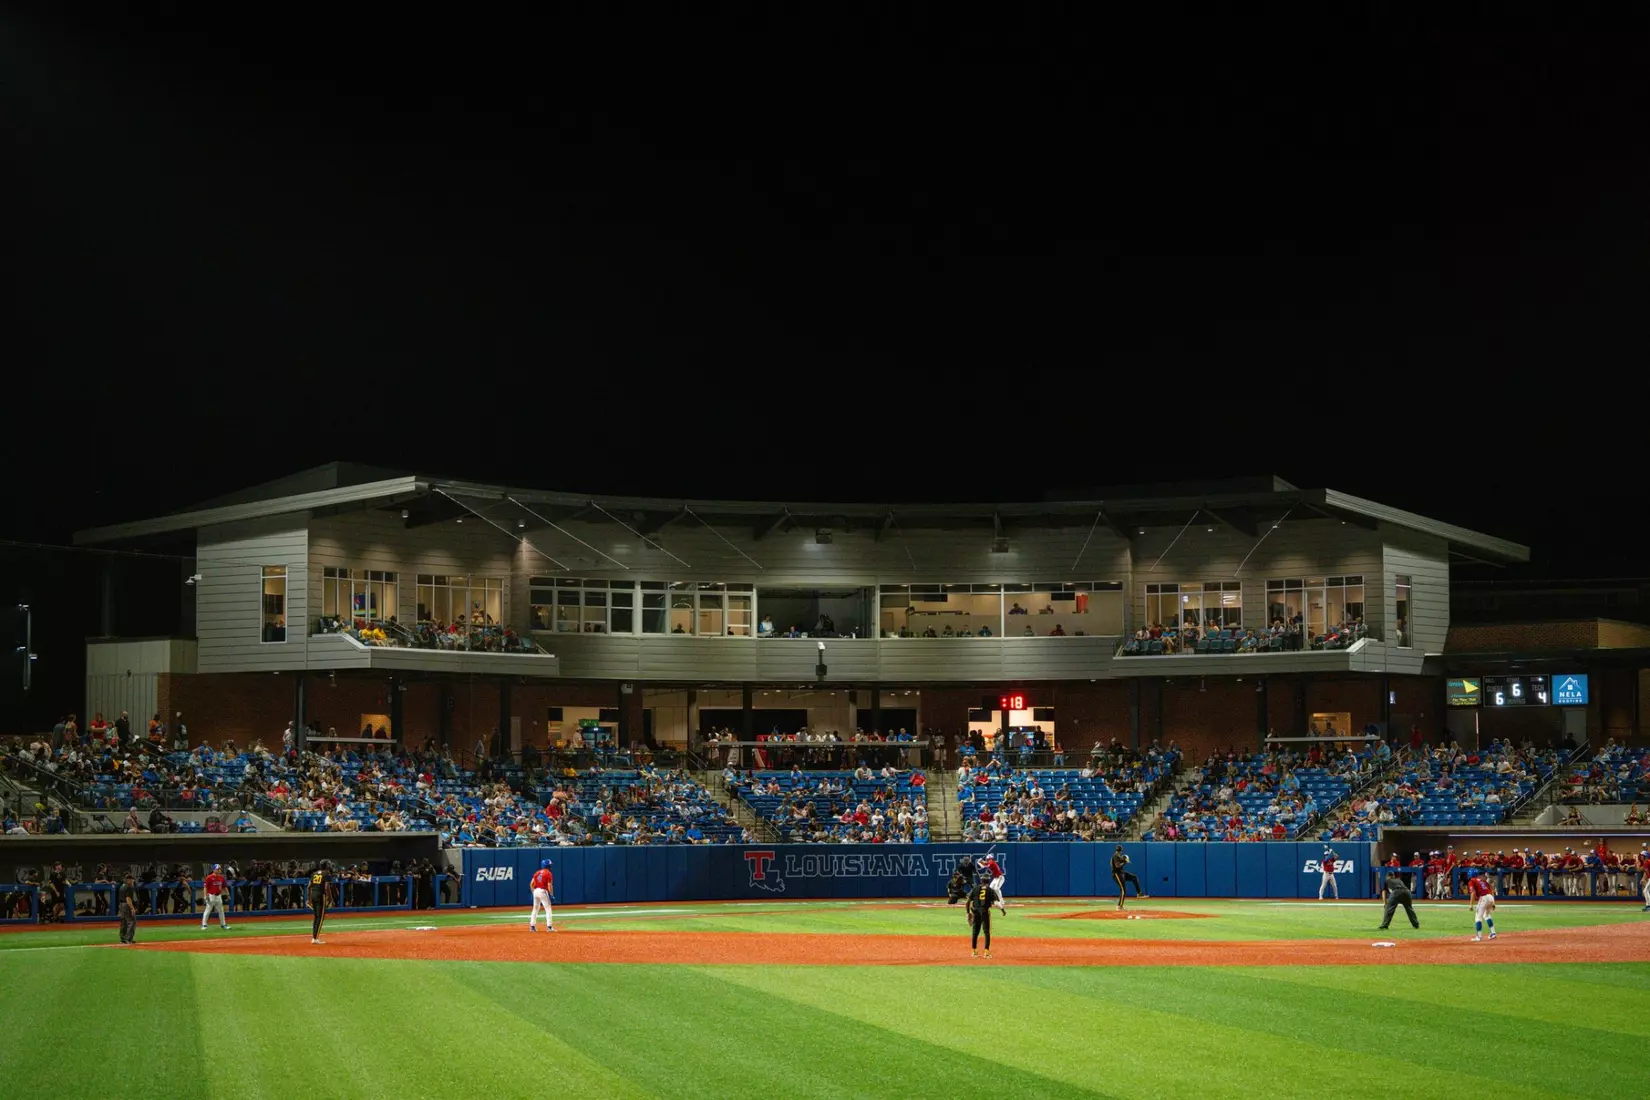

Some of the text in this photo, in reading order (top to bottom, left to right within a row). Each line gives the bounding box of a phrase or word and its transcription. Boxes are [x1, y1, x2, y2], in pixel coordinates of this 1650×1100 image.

[1512, 683, 1521, 697] 6
[1495, 692, 1504, 705] 6
[1538, 692, 1547, 704] 4
[785, 853, 929, 878] LOUISIANA
[312, 874, 323, 884] 20
[979, 890, 986, 901] 2
